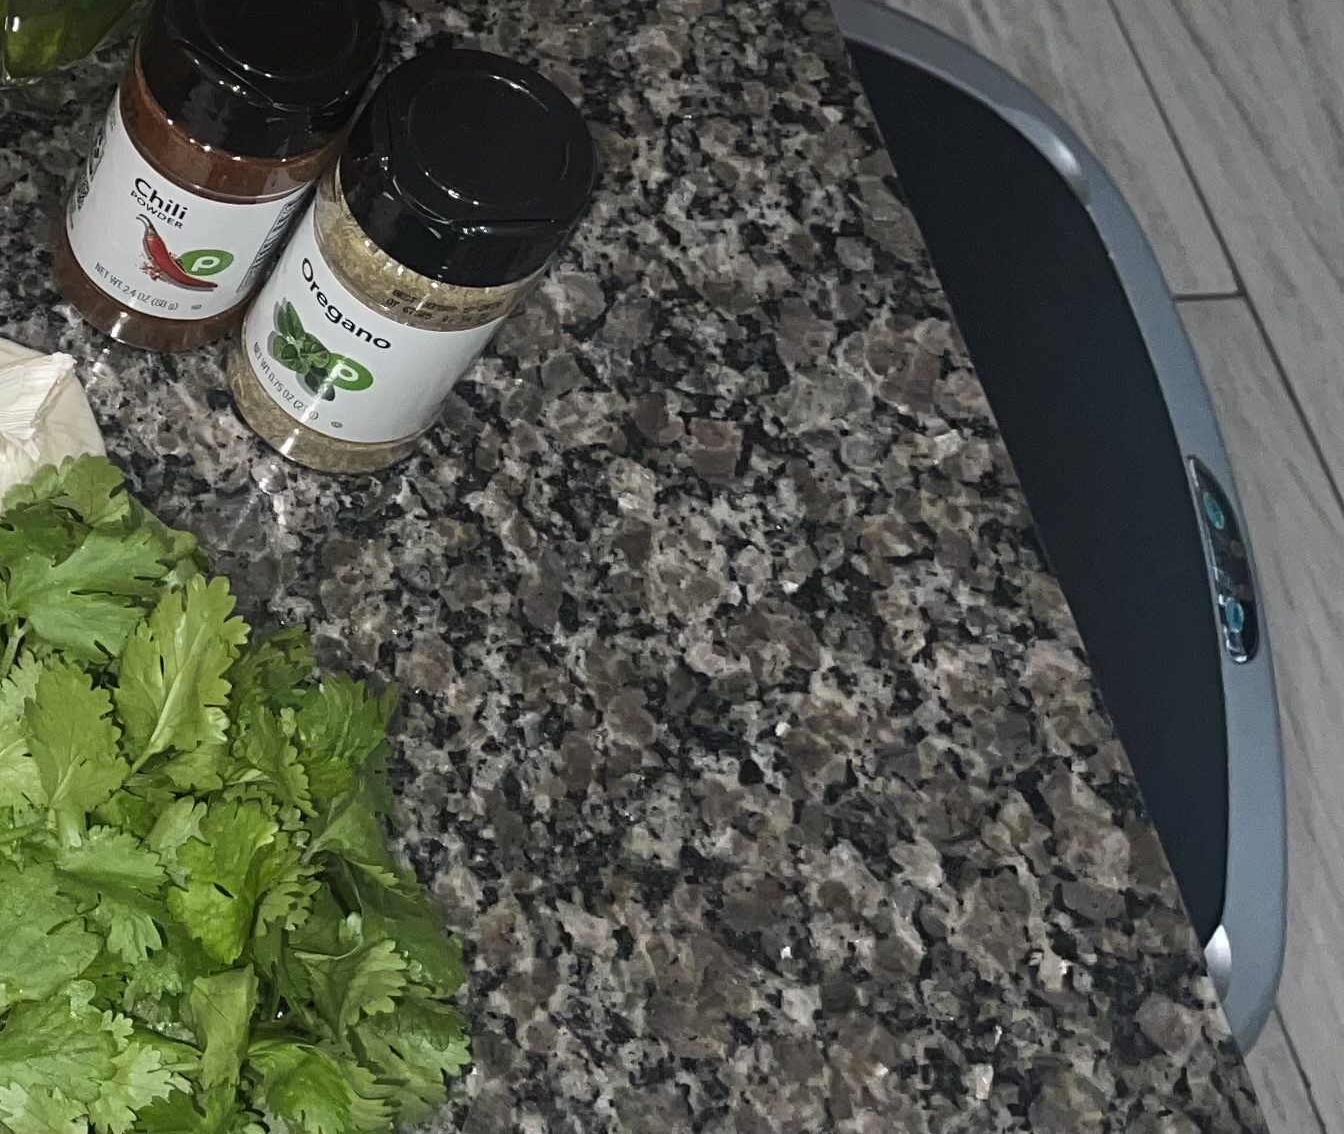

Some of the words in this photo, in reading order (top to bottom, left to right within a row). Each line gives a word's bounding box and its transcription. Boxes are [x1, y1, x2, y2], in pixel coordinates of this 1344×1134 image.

[131, 190, 184, 229] POWDER
[134, 178, 188, 220] Chili
[302, 257, 391, 350] Oregano
